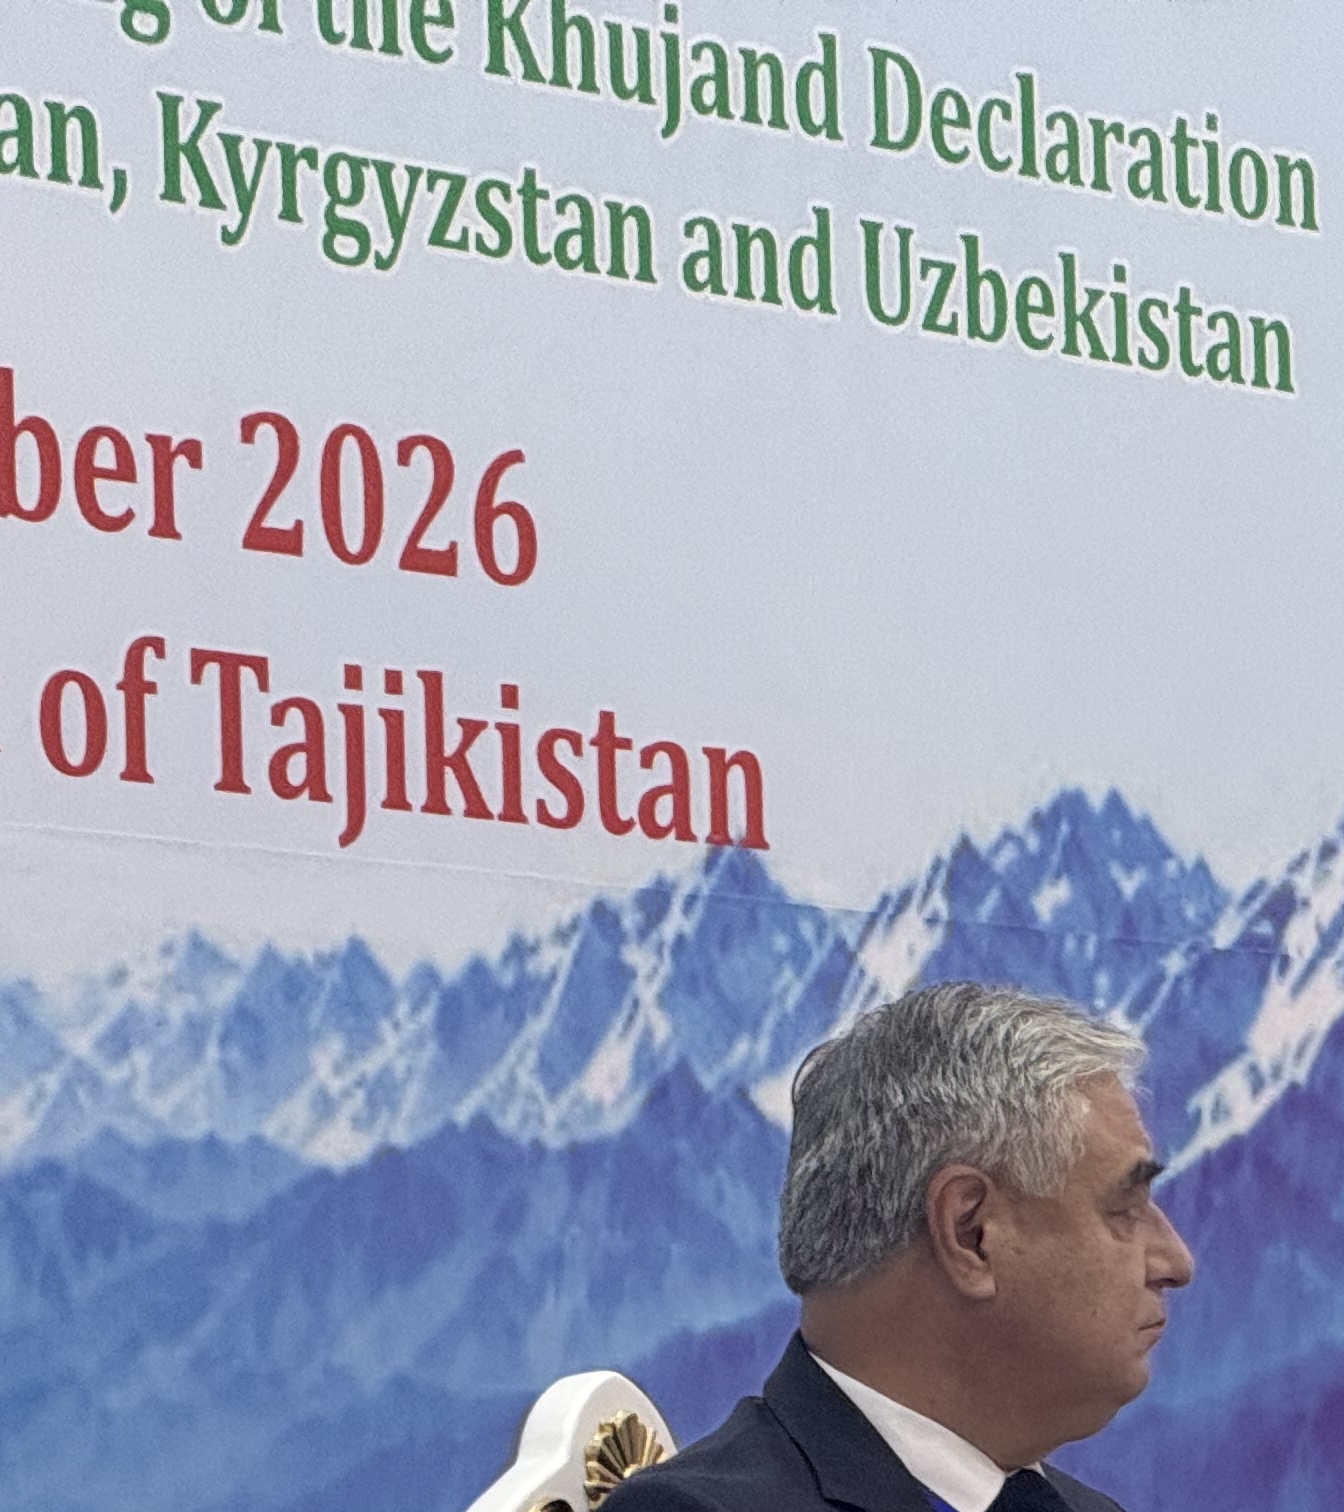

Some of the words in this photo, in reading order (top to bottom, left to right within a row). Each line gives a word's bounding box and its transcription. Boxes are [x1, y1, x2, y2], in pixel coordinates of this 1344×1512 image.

[485, 0, 841, 141] Khujand
[870, 46, 1318, 231] Declaration
[157, 91, 656, 284] Kyrgyzstan
[681, 206, 836, 314] and
[860, 219, 1295, 393] Uzbekistan
[239, 411, 539, 587] 2026
[38, 636, 166, 784] of
[189, 648, 770, 850] Tajikistan
